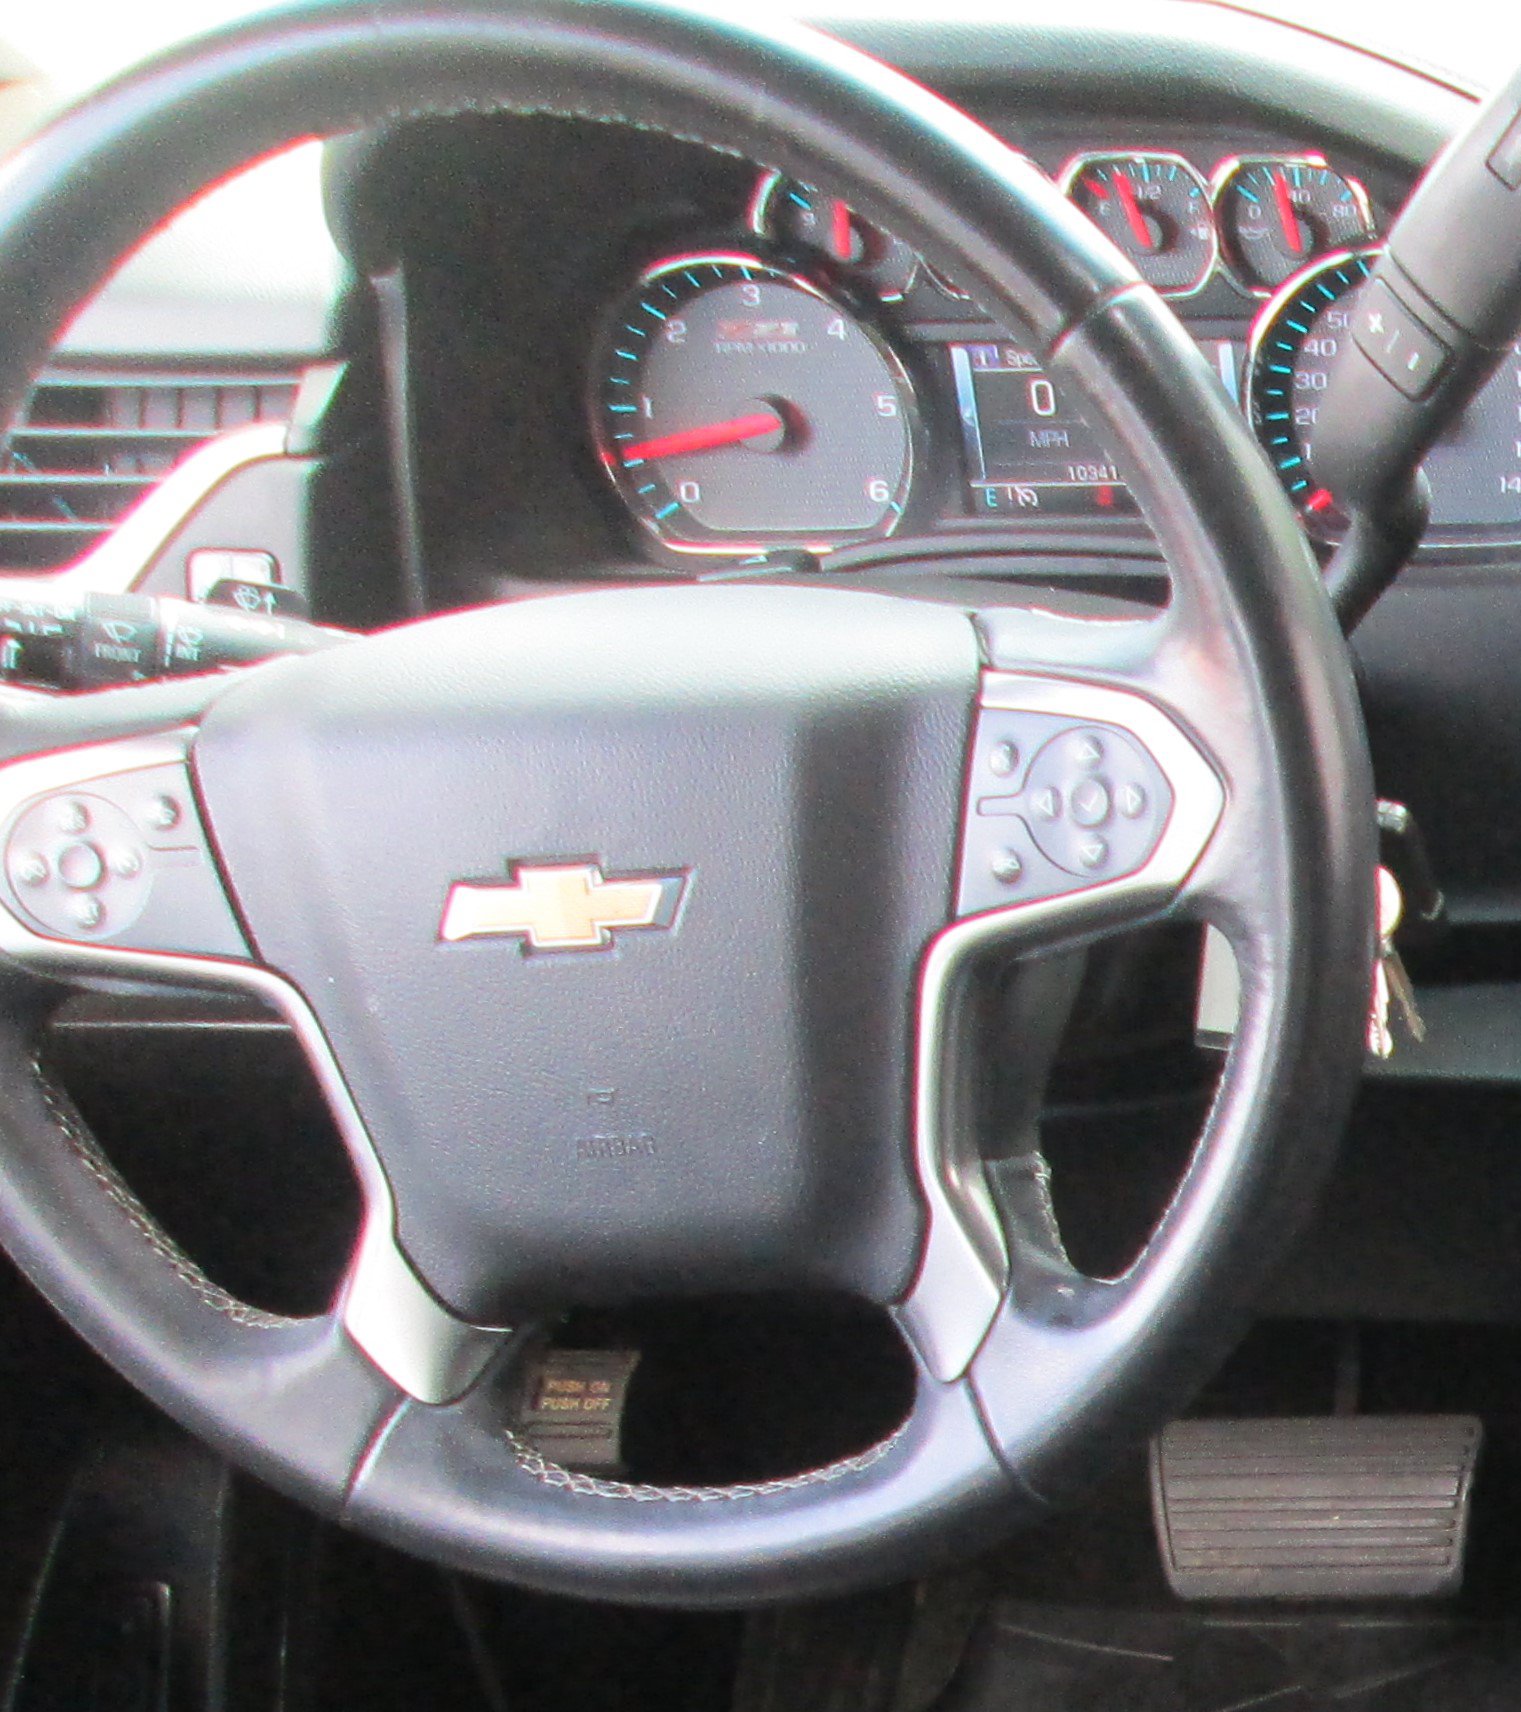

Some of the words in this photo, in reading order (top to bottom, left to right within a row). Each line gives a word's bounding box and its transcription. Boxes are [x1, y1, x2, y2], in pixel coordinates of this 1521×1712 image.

[741, 284, 762, 307] 3
[665, 319, 687, 344] 2
[827, 318, 847, 341] 4
[1303, 338, 1338, 357] 40
[1294, 371, 1328, 391] 30
[643, 395, 653, 418] 1
[875, 394, 897, 418] 5
[1030, 379, 1056, 417] 0
[679, 480, 701, 503] 0
[868, 480, 890, 504] 6
[985, 486, 998, 507] E
